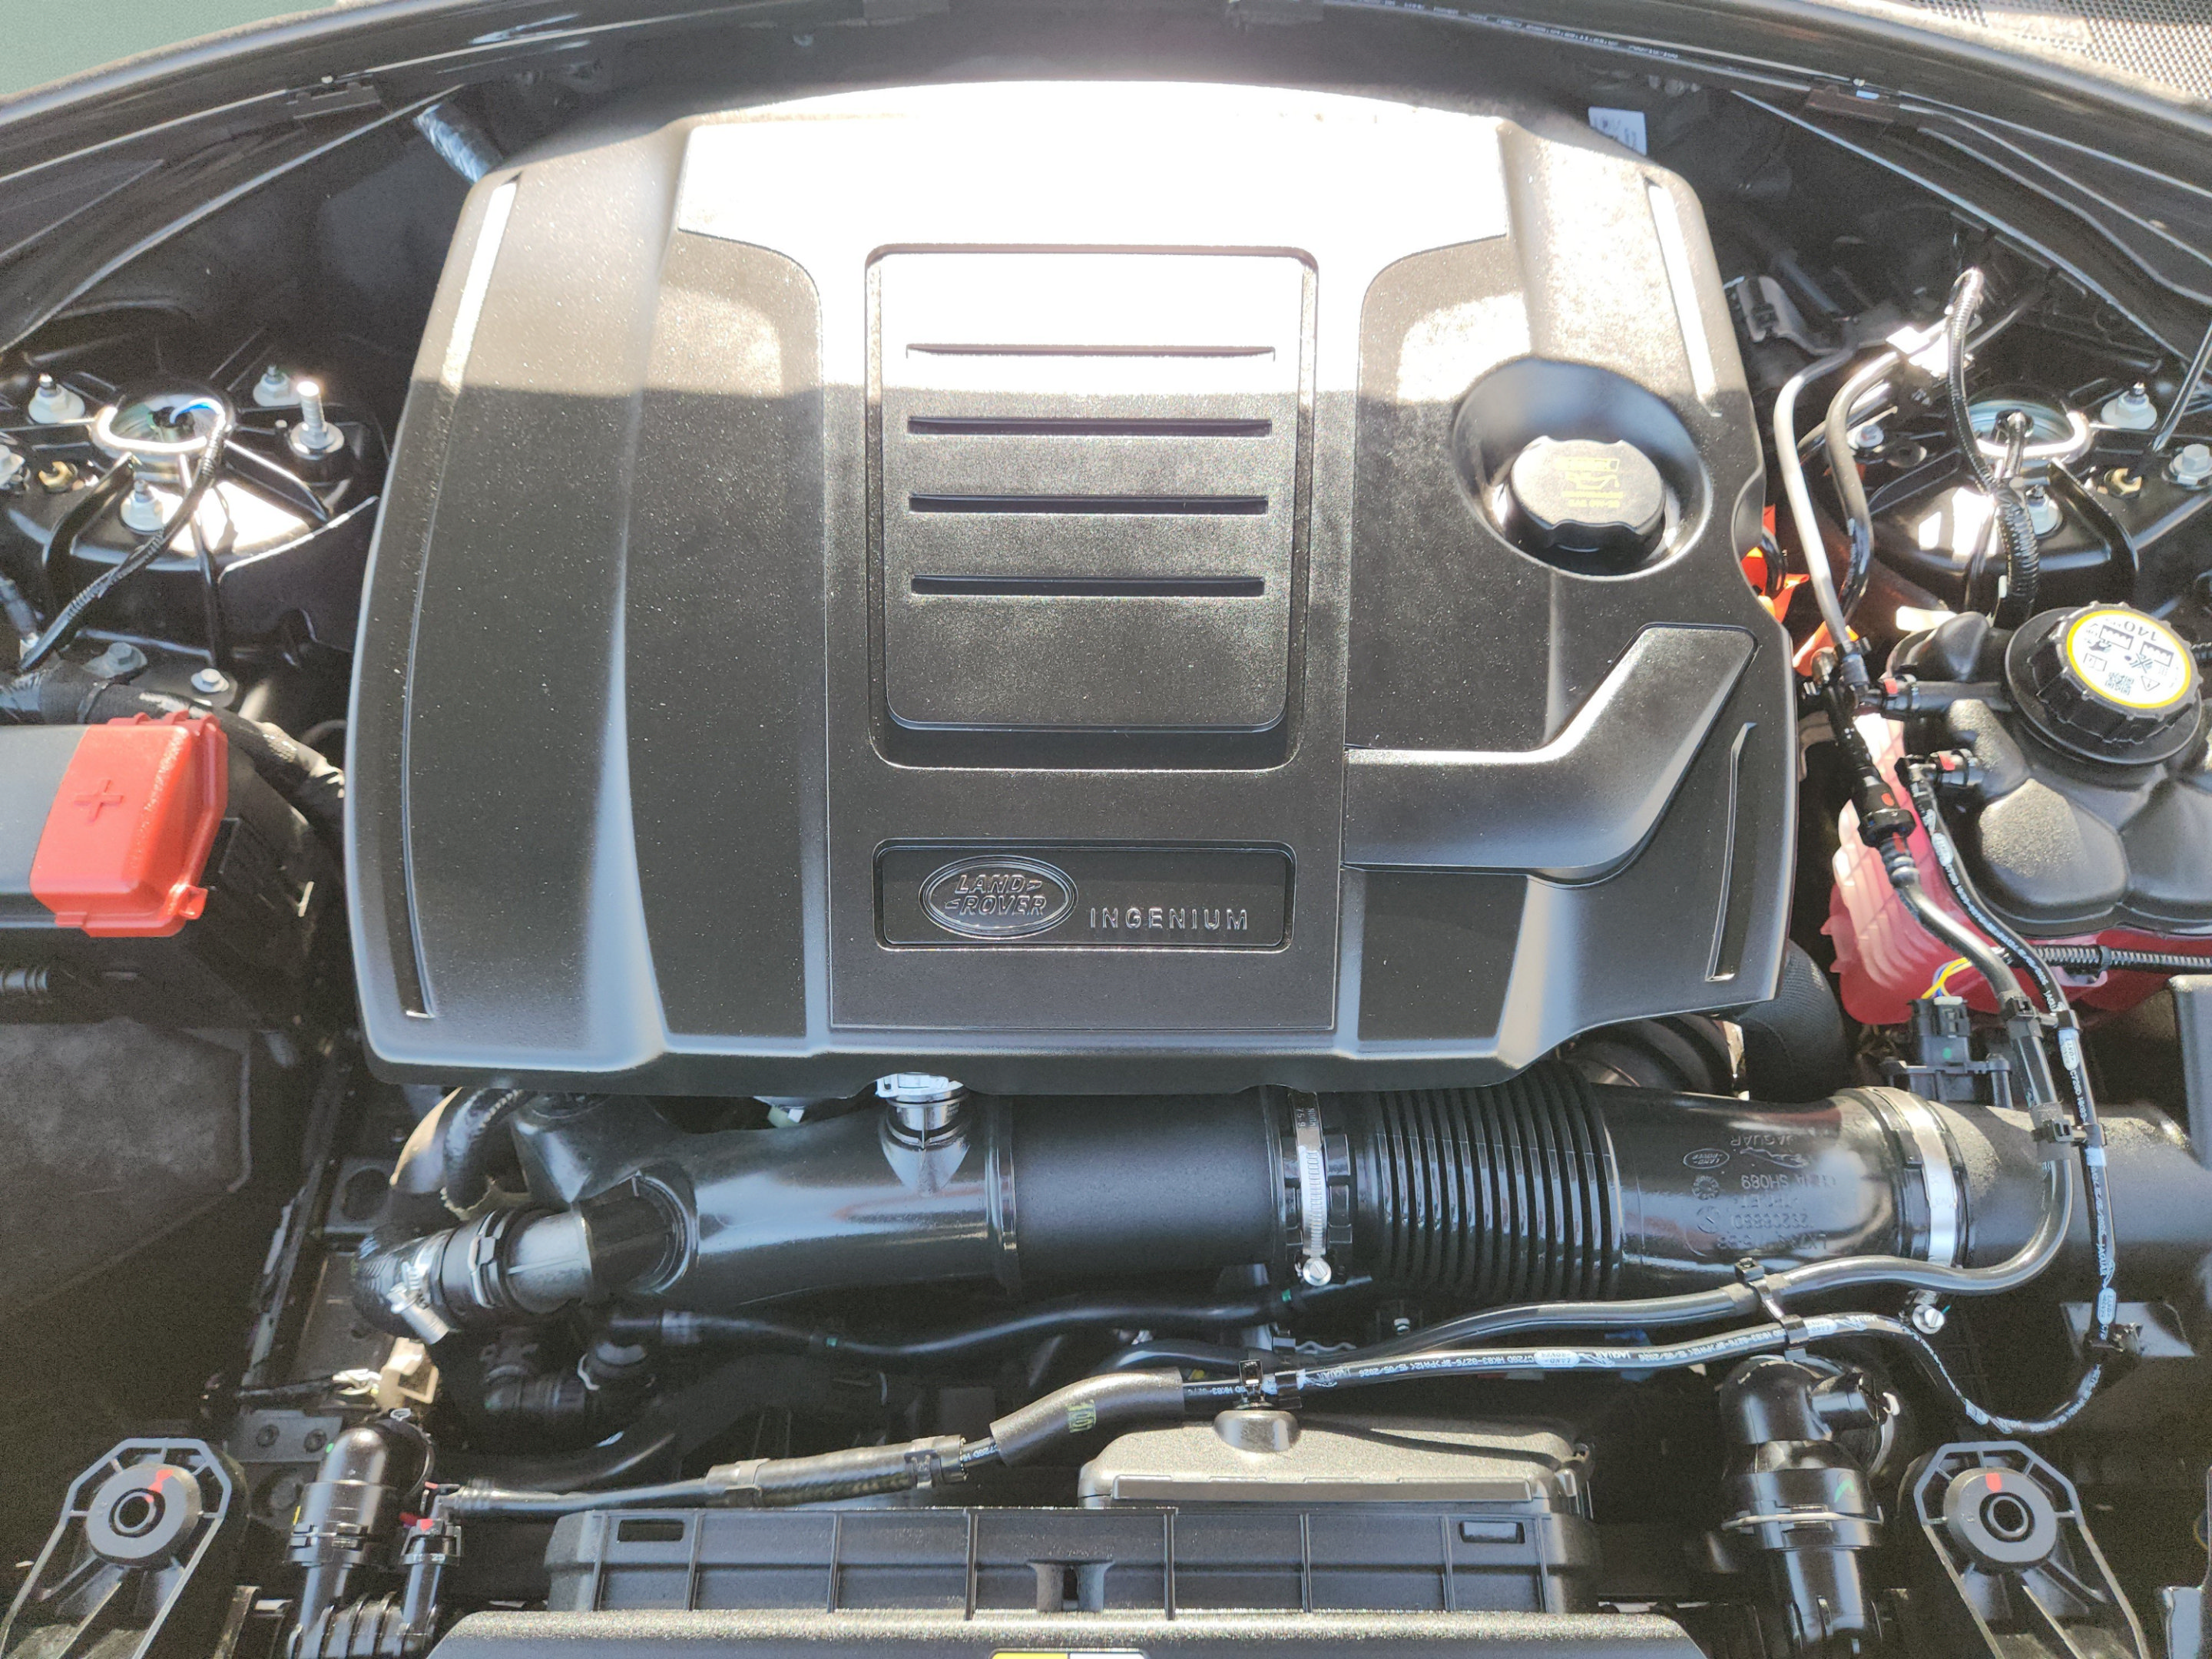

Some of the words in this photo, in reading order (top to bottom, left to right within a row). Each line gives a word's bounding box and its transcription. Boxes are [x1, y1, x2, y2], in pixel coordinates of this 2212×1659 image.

[954, 874, 1025, 895] LAND
[960, 895, 1048, 917] ROVER
[1090, 906, 1248, 931] INGENIUM
[1730, 1134, 1795, 1146] JAGUAR
[1740, 1173, 1789, 1190] SH089
